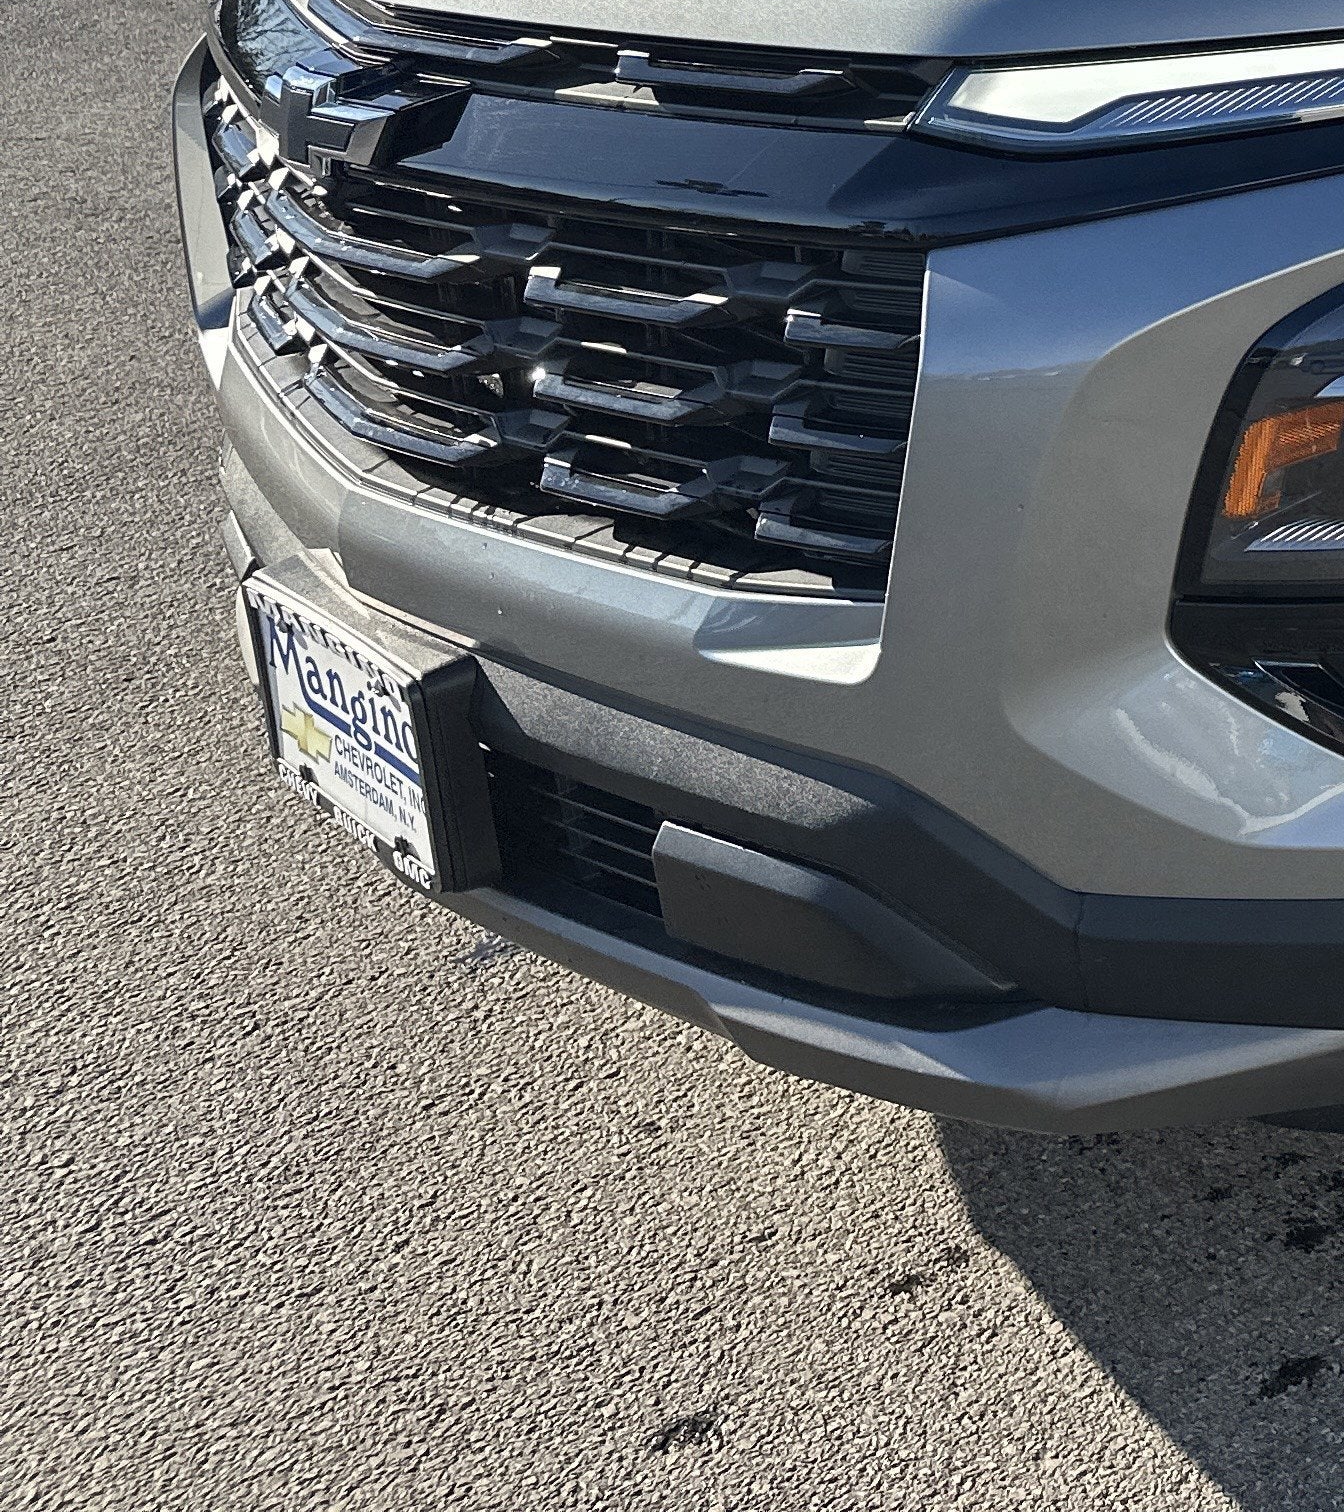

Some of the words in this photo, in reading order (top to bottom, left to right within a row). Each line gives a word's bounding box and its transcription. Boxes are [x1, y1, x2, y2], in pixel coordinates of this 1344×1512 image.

[334, 760, 397, 822] AMSTERDAM,
[333, 805, 377, 853] BUICK
[392, 850, 431, 890] GMC
